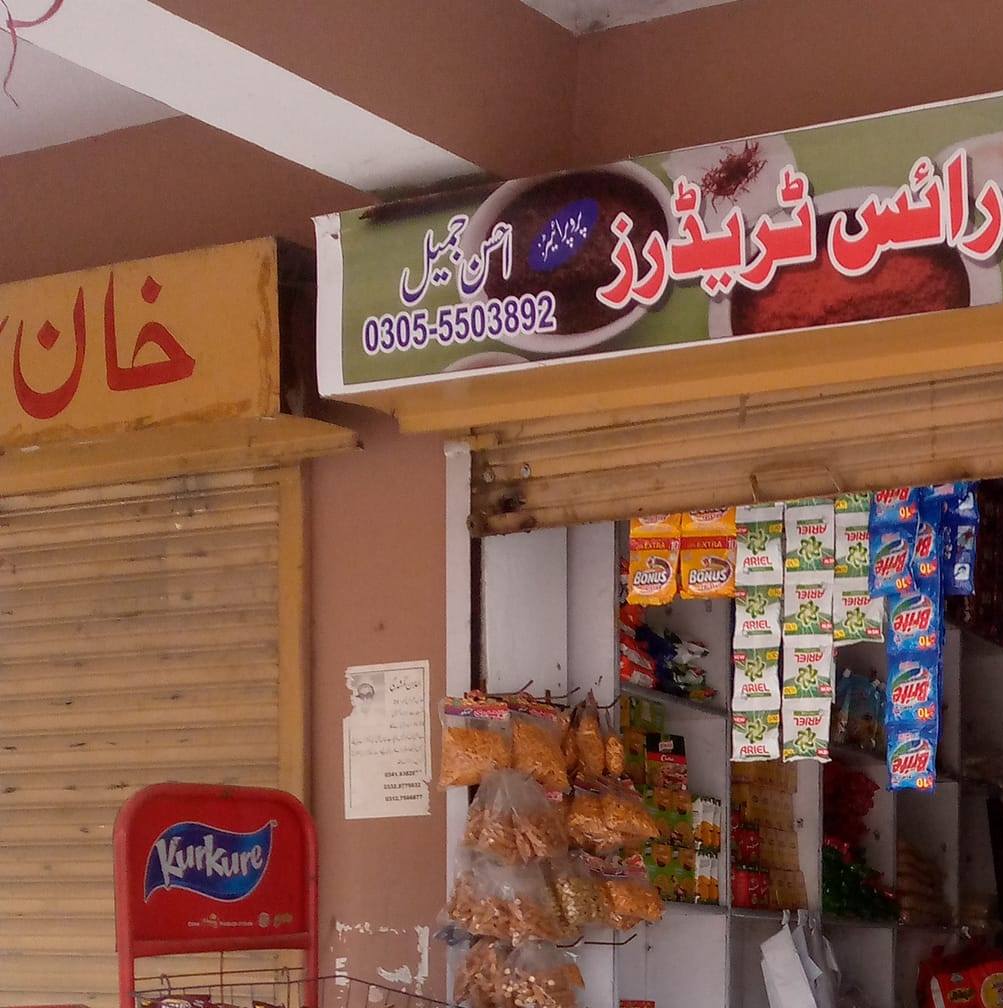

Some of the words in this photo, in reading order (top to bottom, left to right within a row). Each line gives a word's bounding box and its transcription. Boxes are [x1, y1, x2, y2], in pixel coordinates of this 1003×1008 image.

[828, 147, 1003, 275] رائس
[597, 169, 815, 308] ٹریڈرز
[400, 214, 468, 306] جمیل
[459, 222, 512, 295] احسن
[363, 291, 557, 355] 0305-5503892
[13, 271, 195, 420] خان
[797, 525, 827, 535] ARIEL
[743, 557, 772, 566] ARIEL
[633, 571, 667, 584] BONUS
[689, 569, 727, 584] BONUS
[796, 590, 825, 599] ARIEL
[743, 620, 771, 630] ARIEL
[894, 607, 931, 632] Brite
[795, 652, 823, 663] ARIEL
[741, 683, 769, 693] ARIEL
[893, 680, 930, 704] Brite
[794, 715, 822, 726] ARIEL
[740, 745, 769, 754] ARIEL
[891, 751, 929, 774] Brite
[154, 834, 264, 890] Kurkure
